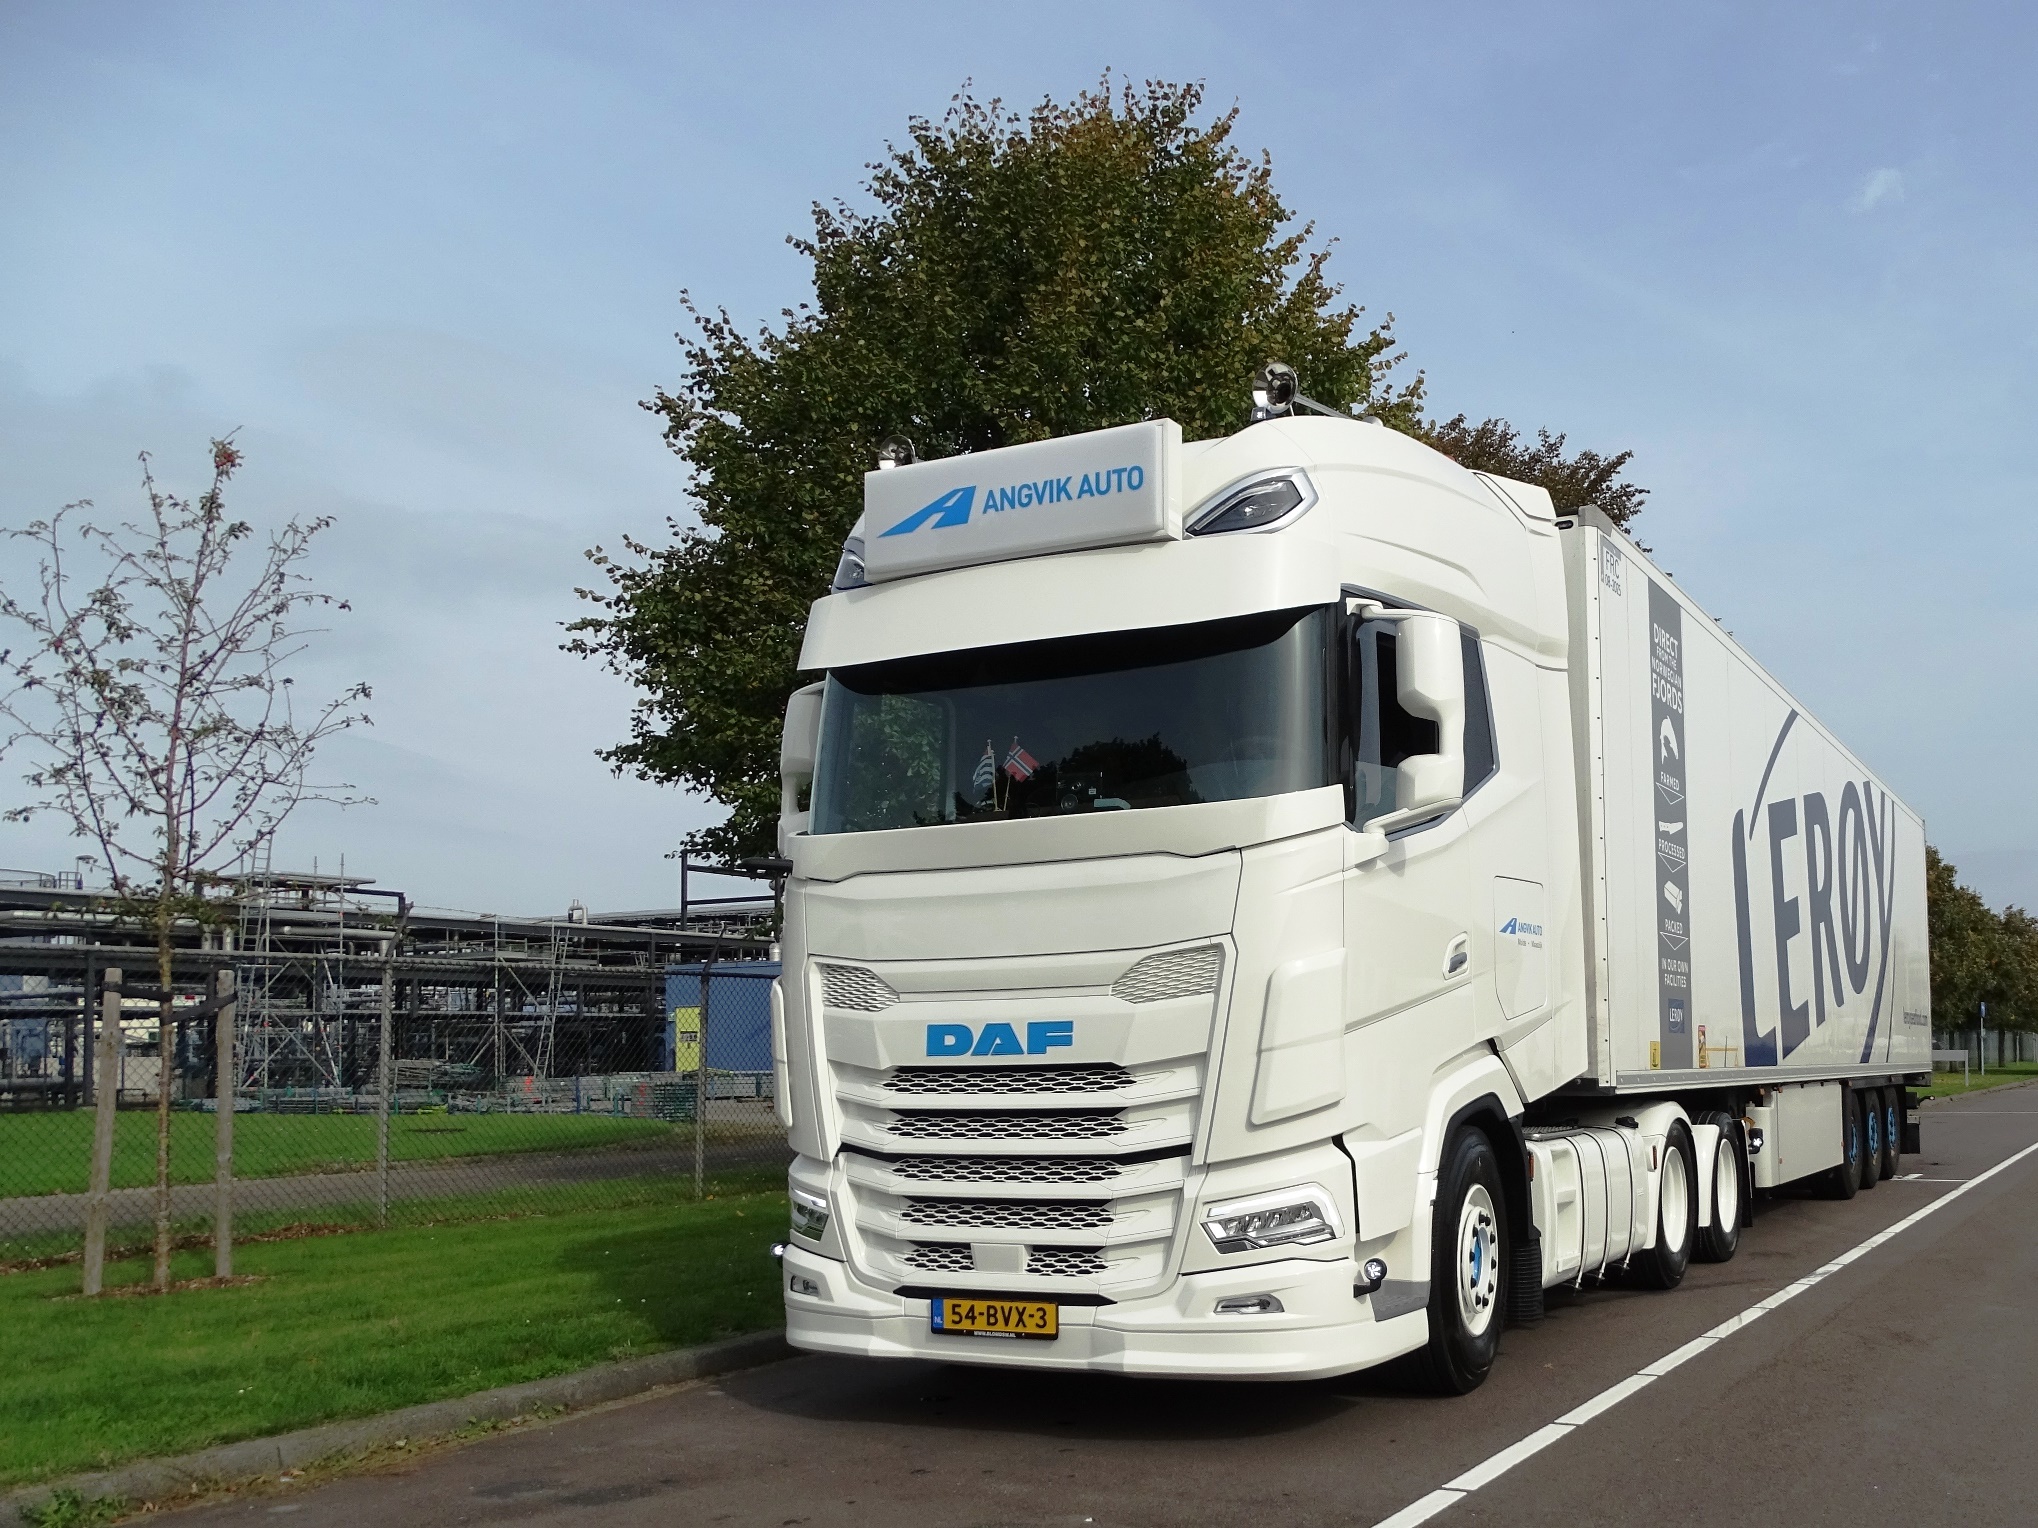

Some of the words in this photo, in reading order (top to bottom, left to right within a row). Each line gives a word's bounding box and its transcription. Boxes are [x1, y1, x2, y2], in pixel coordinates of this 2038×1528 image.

[982, 476, 1073, 514] ANGVIK
[1077, 465, 1144, 499] AUTO
[1653, 622, 1679, 659] DIRECT
[1652, 672, 1683, 714] FJORDS
[1660, 771, 1680, 791] FARMED
[1658, 838, 1685, 860] PROCESSED
[1664, 918, 1683, 934] PACKED
[1664, 973, 1687, 988] FACILITIES
[926, 1020, 1074, 1057] DAF
[934, 1315, 943, 1324] NL
[951, 1303, 1048, 1329] 54-BVX-3
